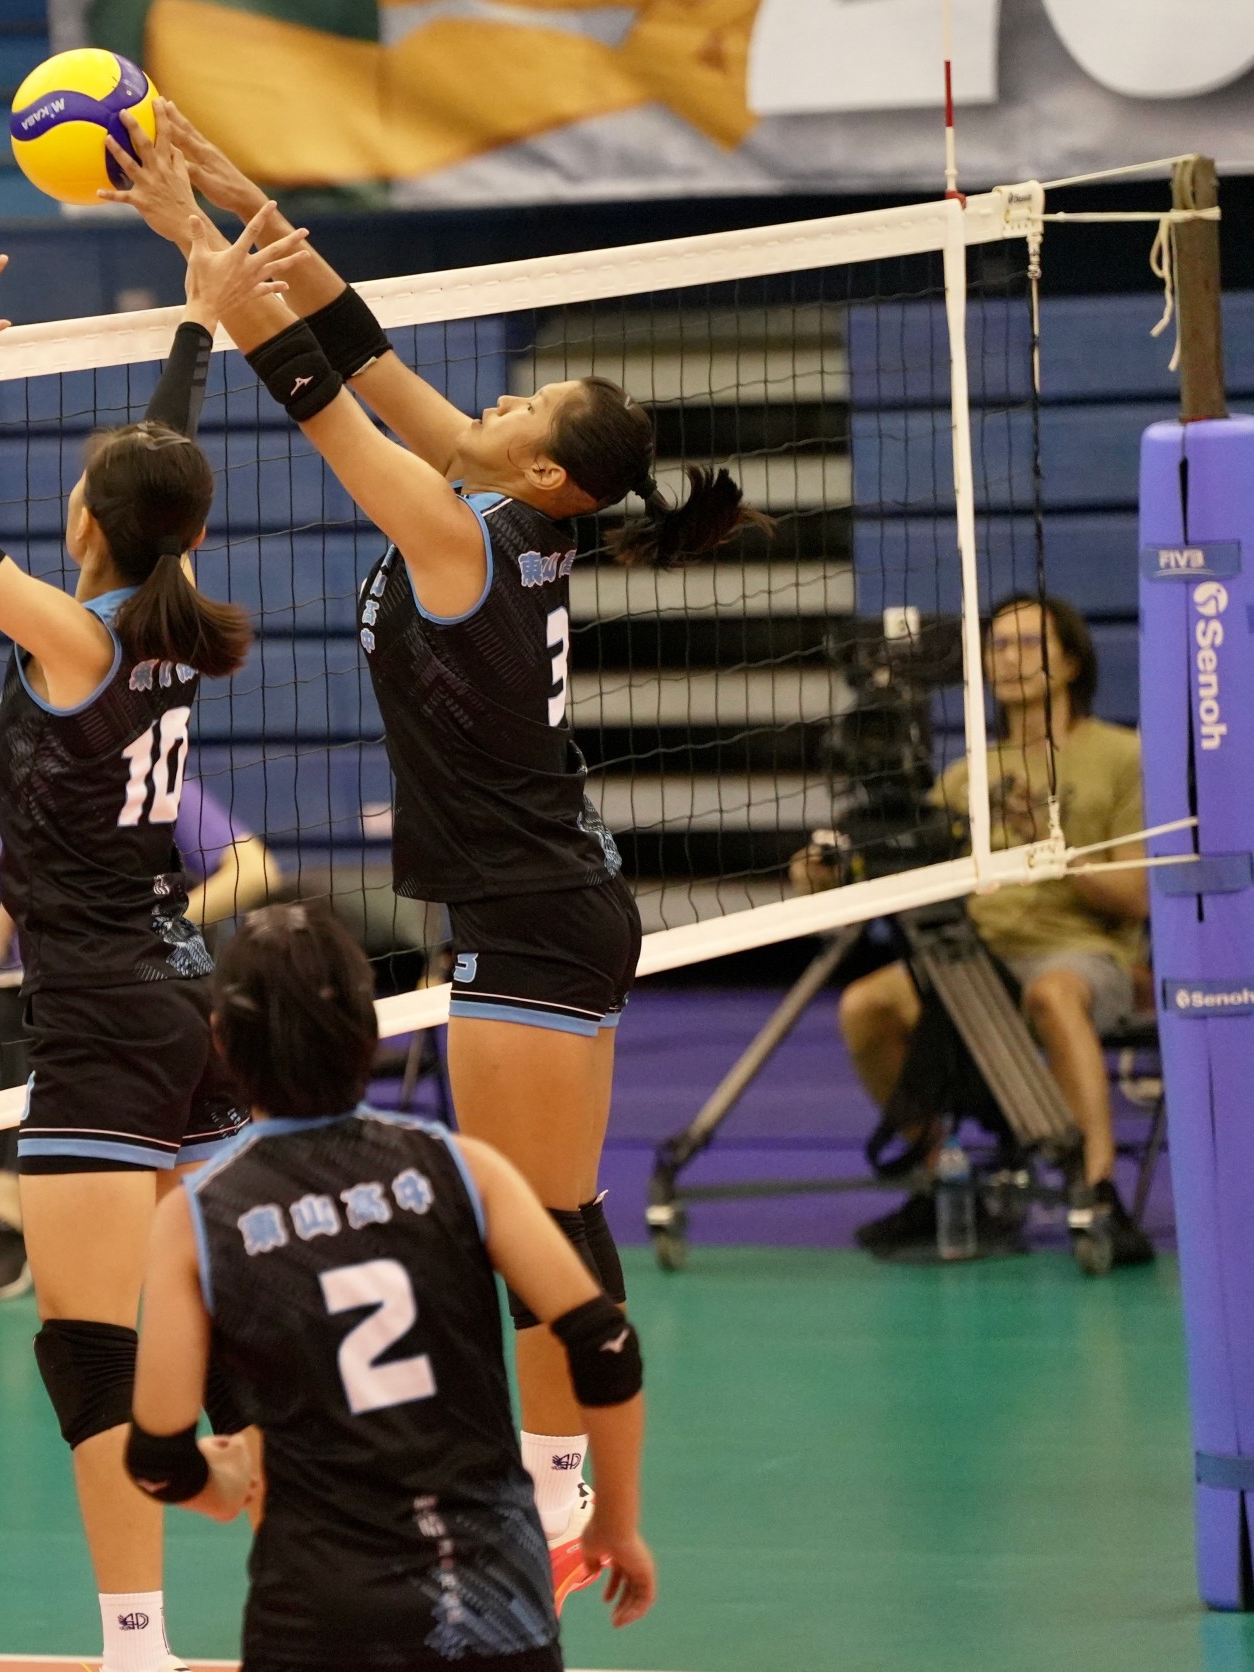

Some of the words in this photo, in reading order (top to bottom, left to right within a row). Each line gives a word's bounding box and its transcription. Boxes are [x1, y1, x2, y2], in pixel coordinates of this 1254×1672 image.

[1196, 618, 1227, 750] Senoh
[117, 706, 191, 827] 10
[317, 1258, 438, 1416] 2
